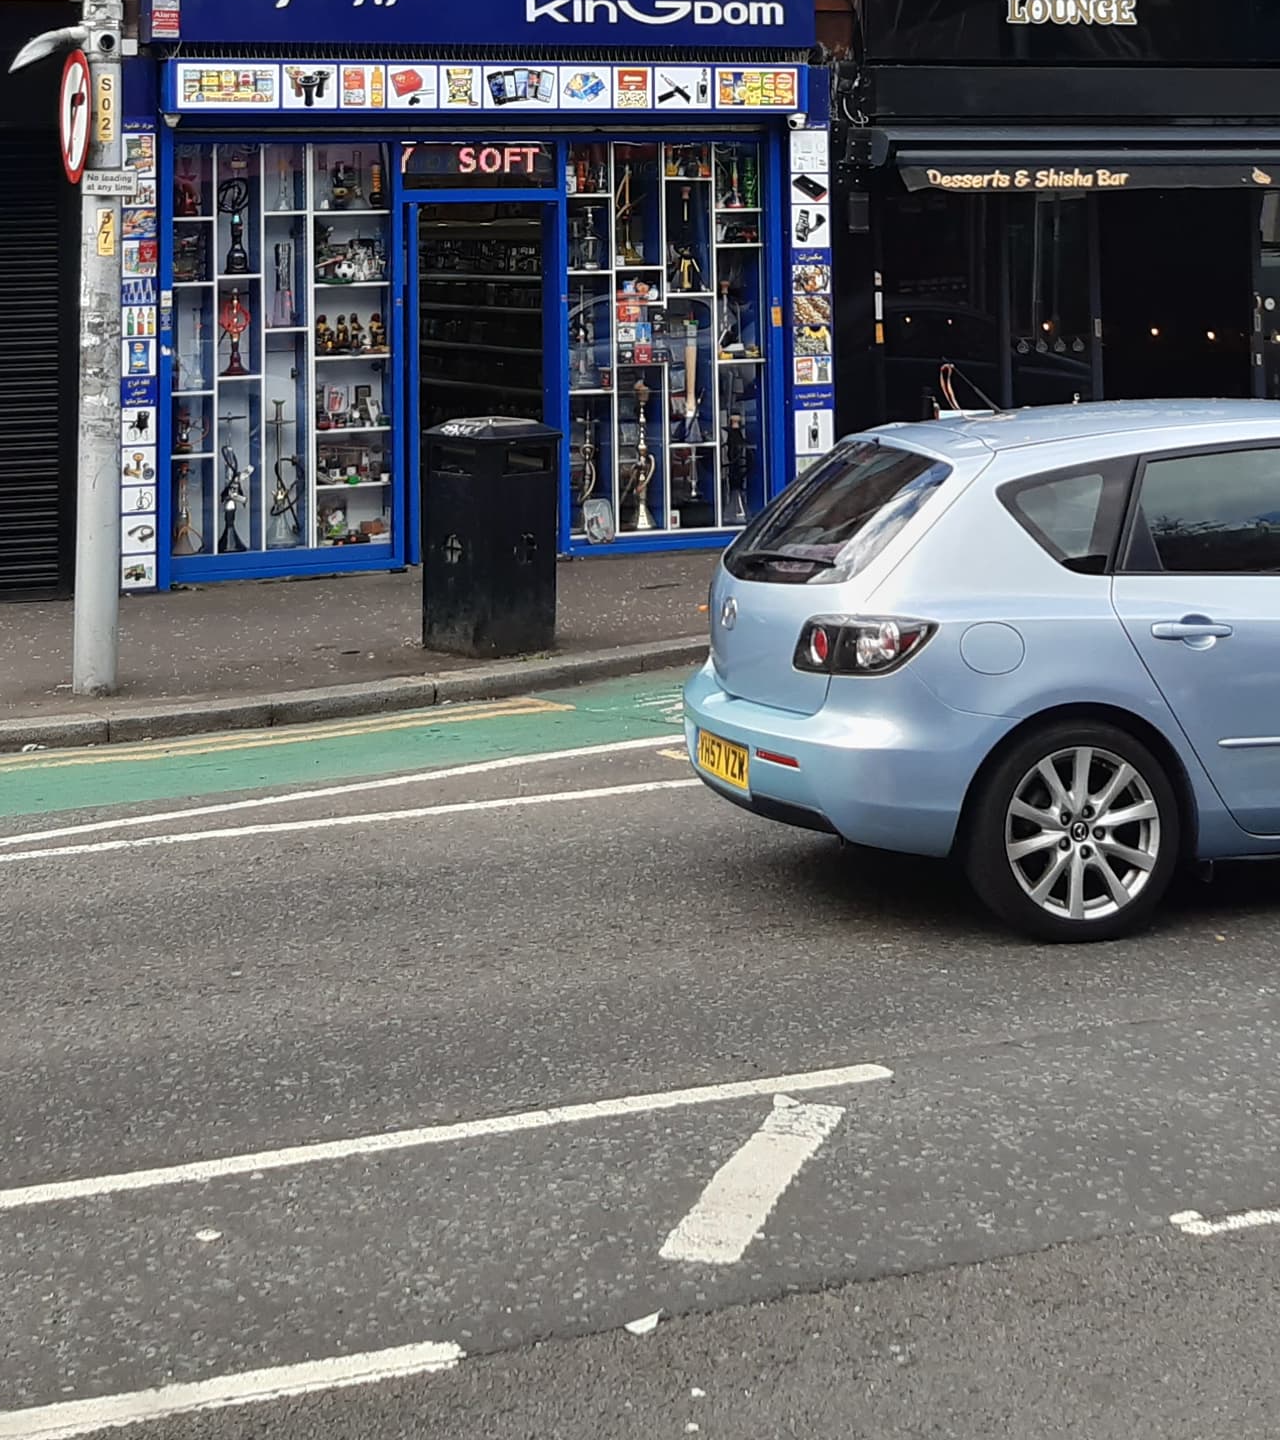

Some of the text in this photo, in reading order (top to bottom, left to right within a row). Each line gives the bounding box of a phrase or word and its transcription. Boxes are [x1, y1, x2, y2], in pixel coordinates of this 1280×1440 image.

[458, 146, 540, 174] SOFT
[86, 173, 133, 184] No loading
[926, 167, 1130, 189] Desserts & Shisha Bar
[86, 182, 134, 193] at any time
